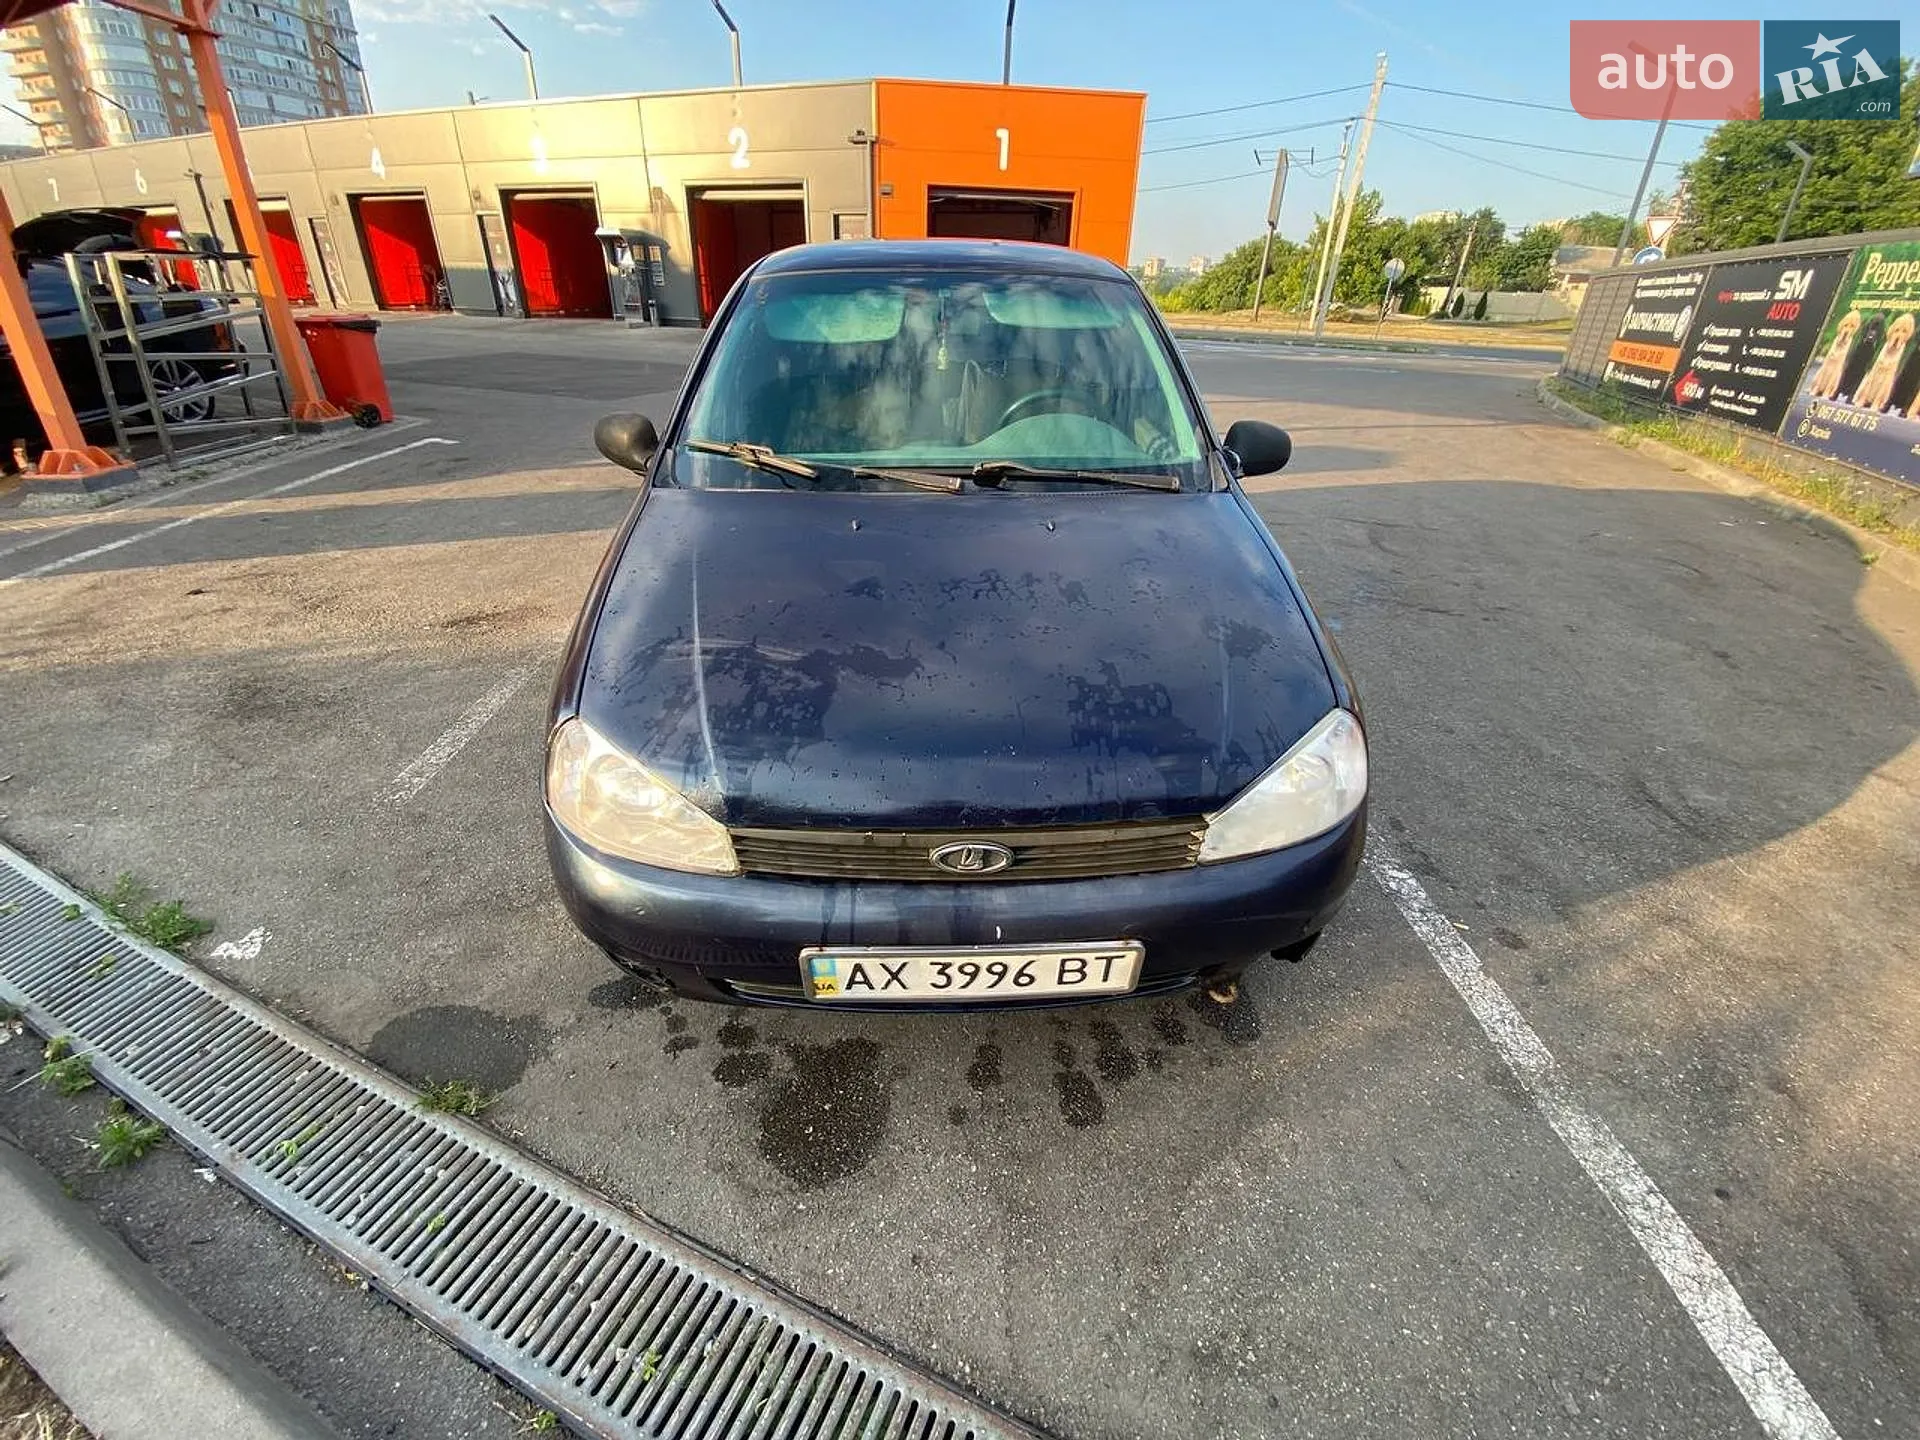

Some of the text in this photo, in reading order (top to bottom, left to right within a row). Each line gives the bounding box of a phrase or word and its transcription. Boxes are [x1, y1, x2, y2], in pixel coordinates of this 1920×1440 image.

[370, 146, 386, 181] 4
[727, 126, 750, 169] 2
[995, 128, 1010, 171] 1
[47, 177, 60, 202] 7
[134, 167, 148, 195] 6
[1774, 268, 1814, 300] SM
[1767, 302, 1801, 321] AUTO
[845, 954, 1126, 990] AX 3996 BT
